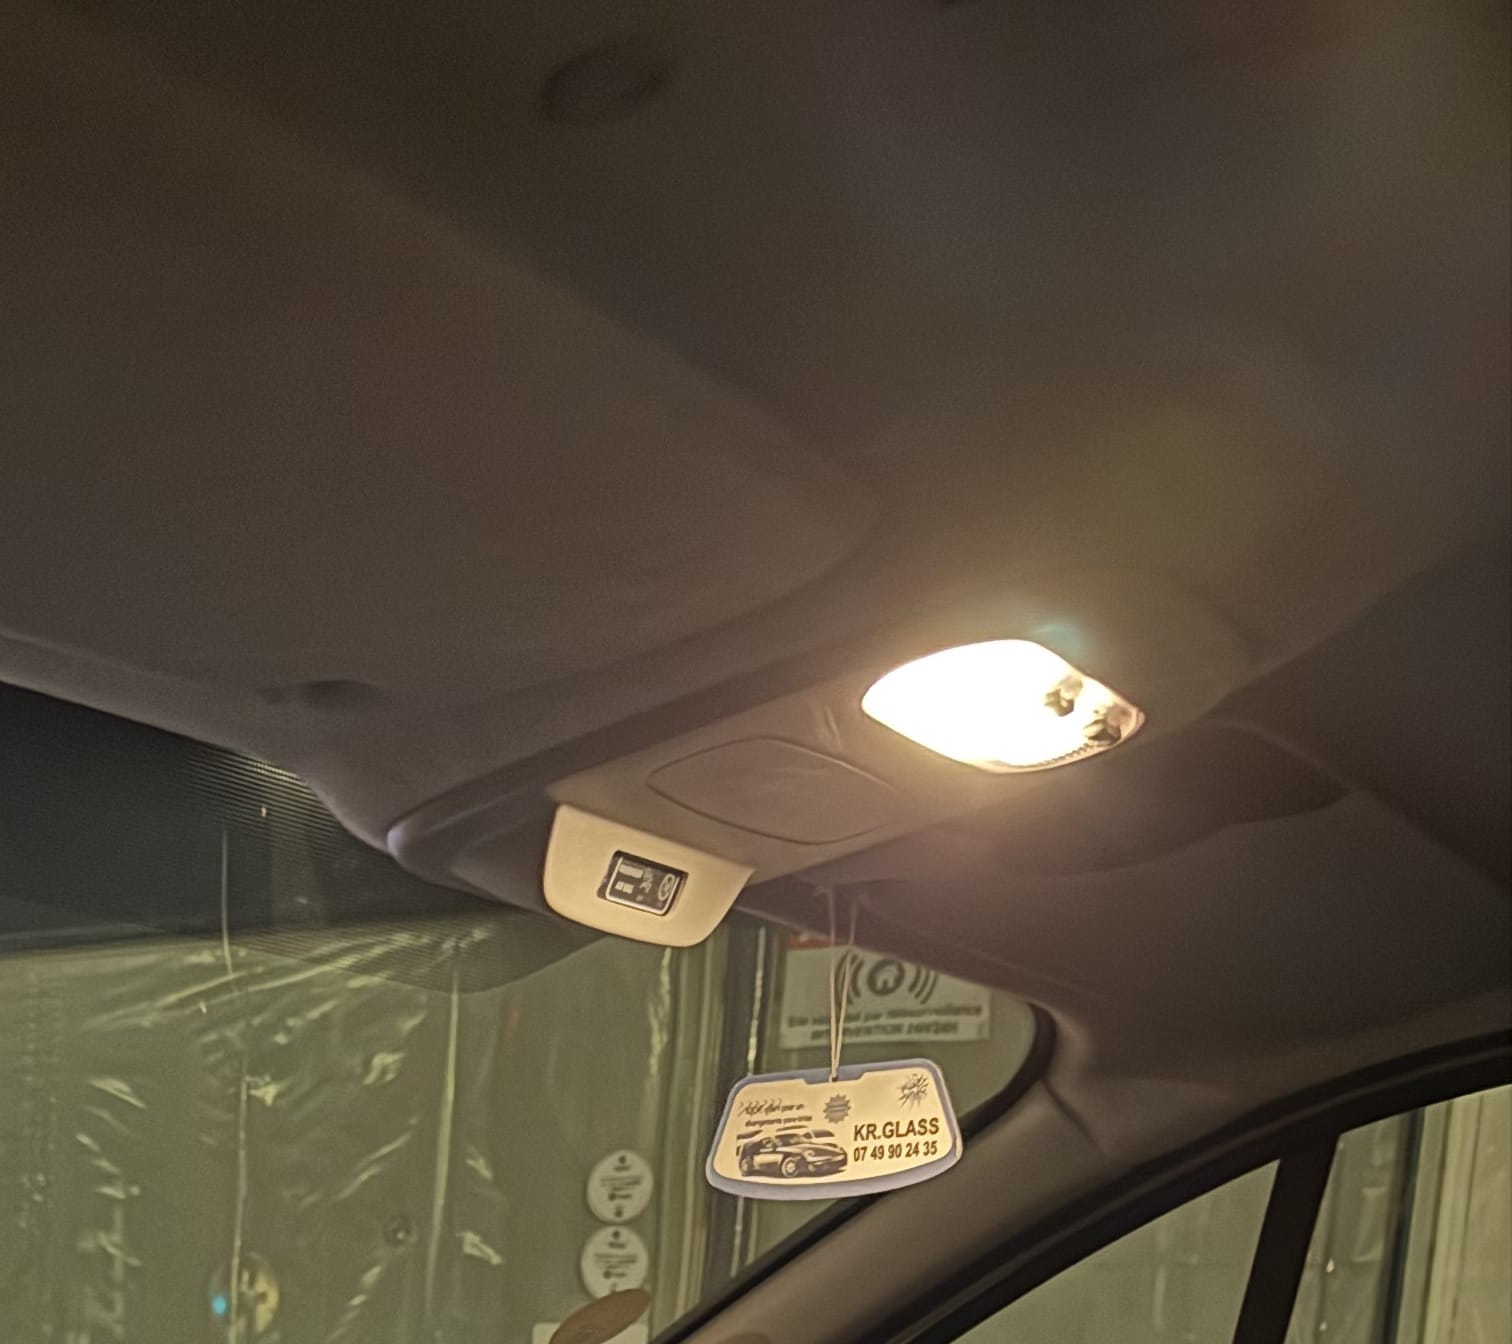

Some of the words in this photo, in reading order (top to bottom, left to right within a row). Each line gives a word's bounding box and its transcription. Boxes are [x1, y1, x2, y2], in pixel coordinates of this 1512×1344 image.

[853, 1117, 940, 1142] KR.GLASS
[853, 1146, 868, 1163] 07
[870, 1144, 885, 1161] 49
[888, 1143, 903, 1160] 90
[905, 1141, 920, 1158] 24
[923, 1140, 938, 1157] 35
